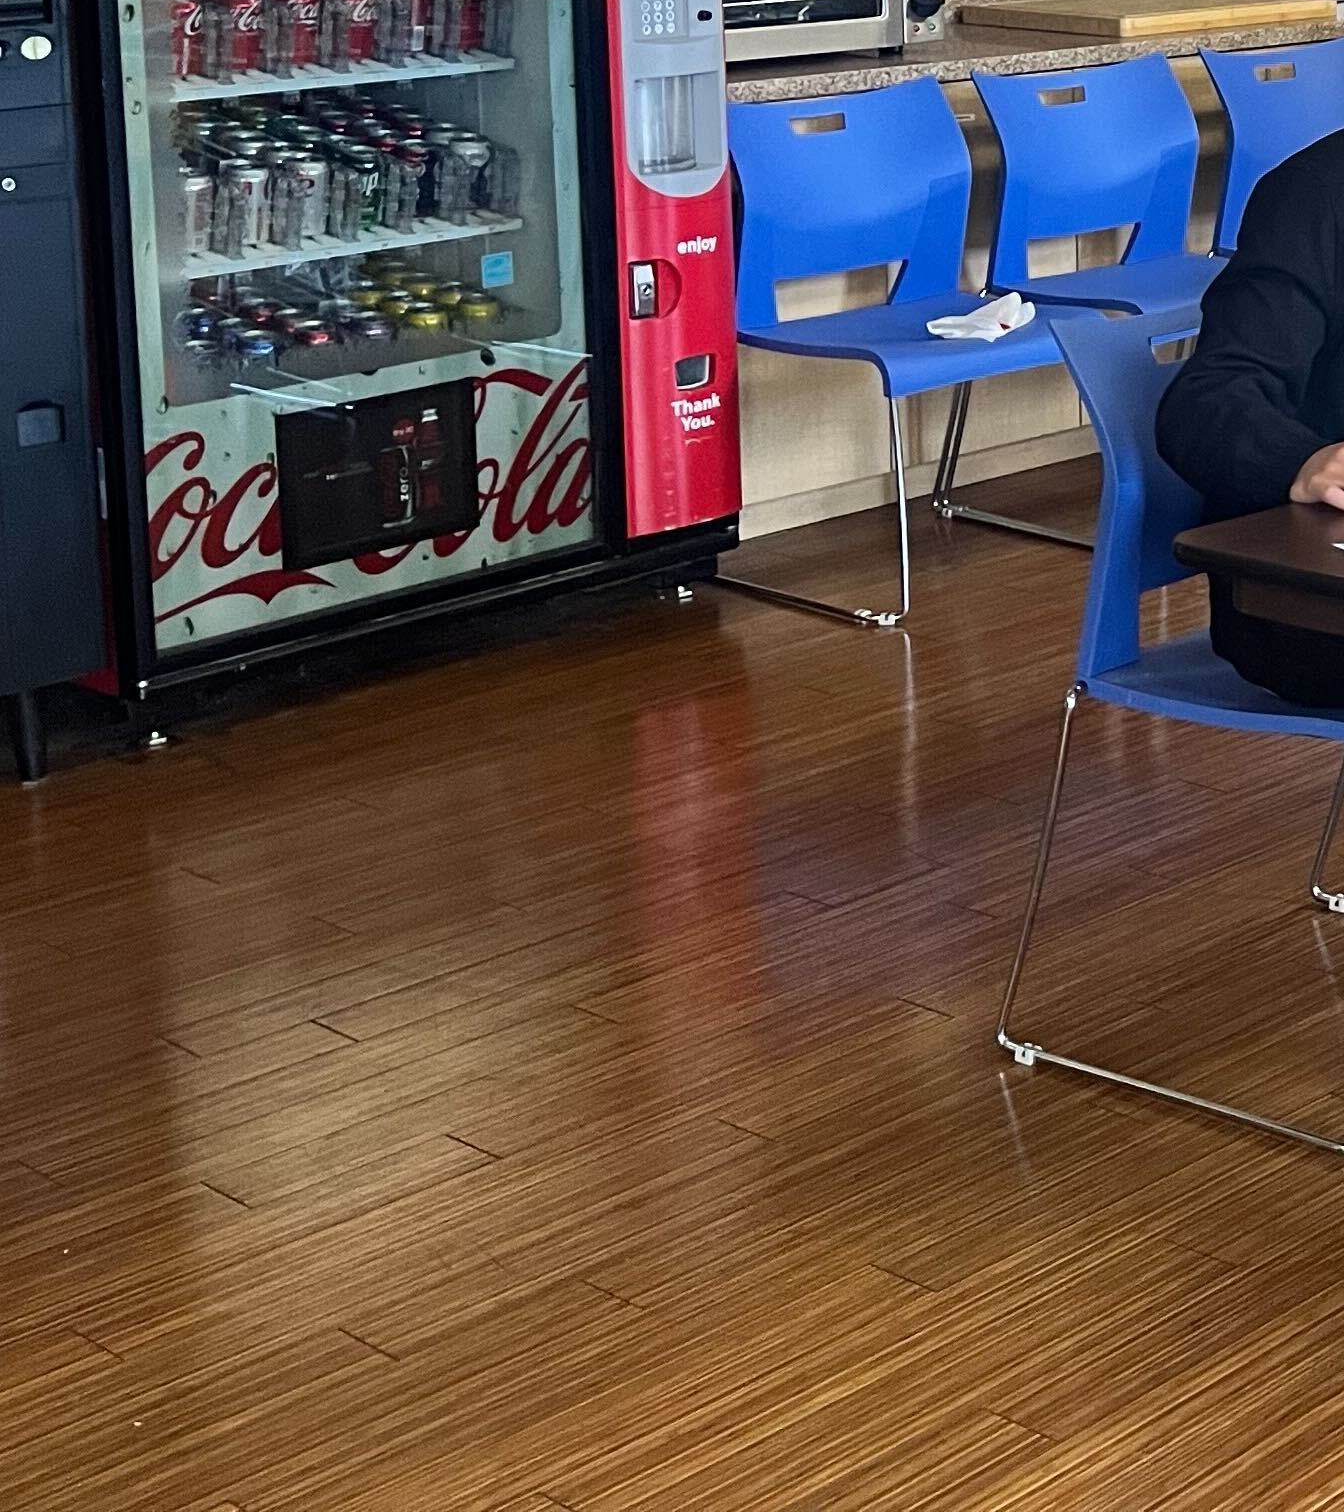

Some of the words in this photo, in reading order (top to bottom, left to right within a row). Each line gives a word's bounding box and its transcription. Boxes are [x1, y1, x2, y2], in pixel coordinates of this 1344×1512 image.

[677, 235, 718, 255] enjoy
[671, 392, 721, 416] Thank
[680, 414, 716, 432] You.
